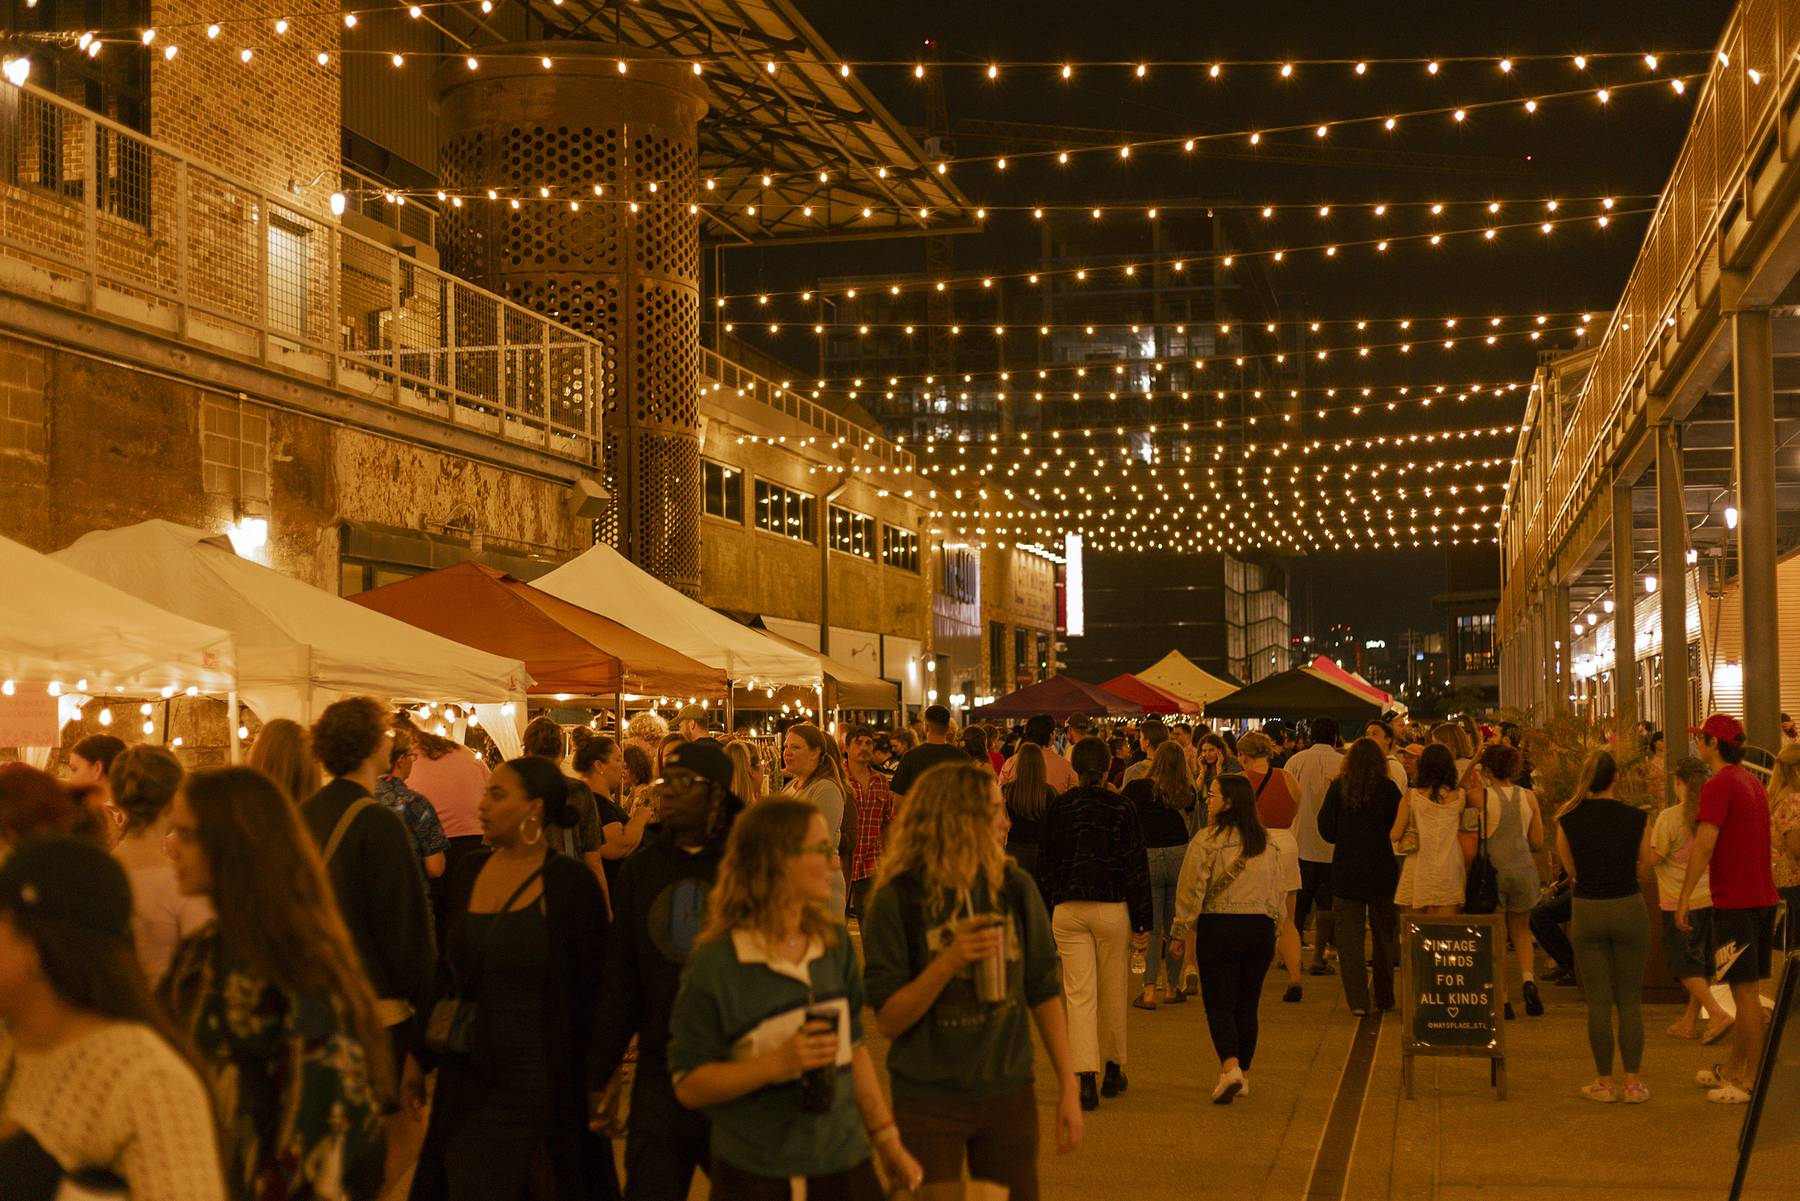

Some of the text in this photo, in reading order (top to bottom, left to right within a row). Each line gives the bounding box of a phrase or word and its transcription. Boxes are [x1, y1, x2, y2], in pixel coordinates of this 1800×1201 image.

[1715, 940, 1737, 968] NIKE
[1435, 955, 1474, 967] FINDS
[1437, 974, 1465, 986] FOR
[1421, 993, 1488, 1005] ALL KINDS
